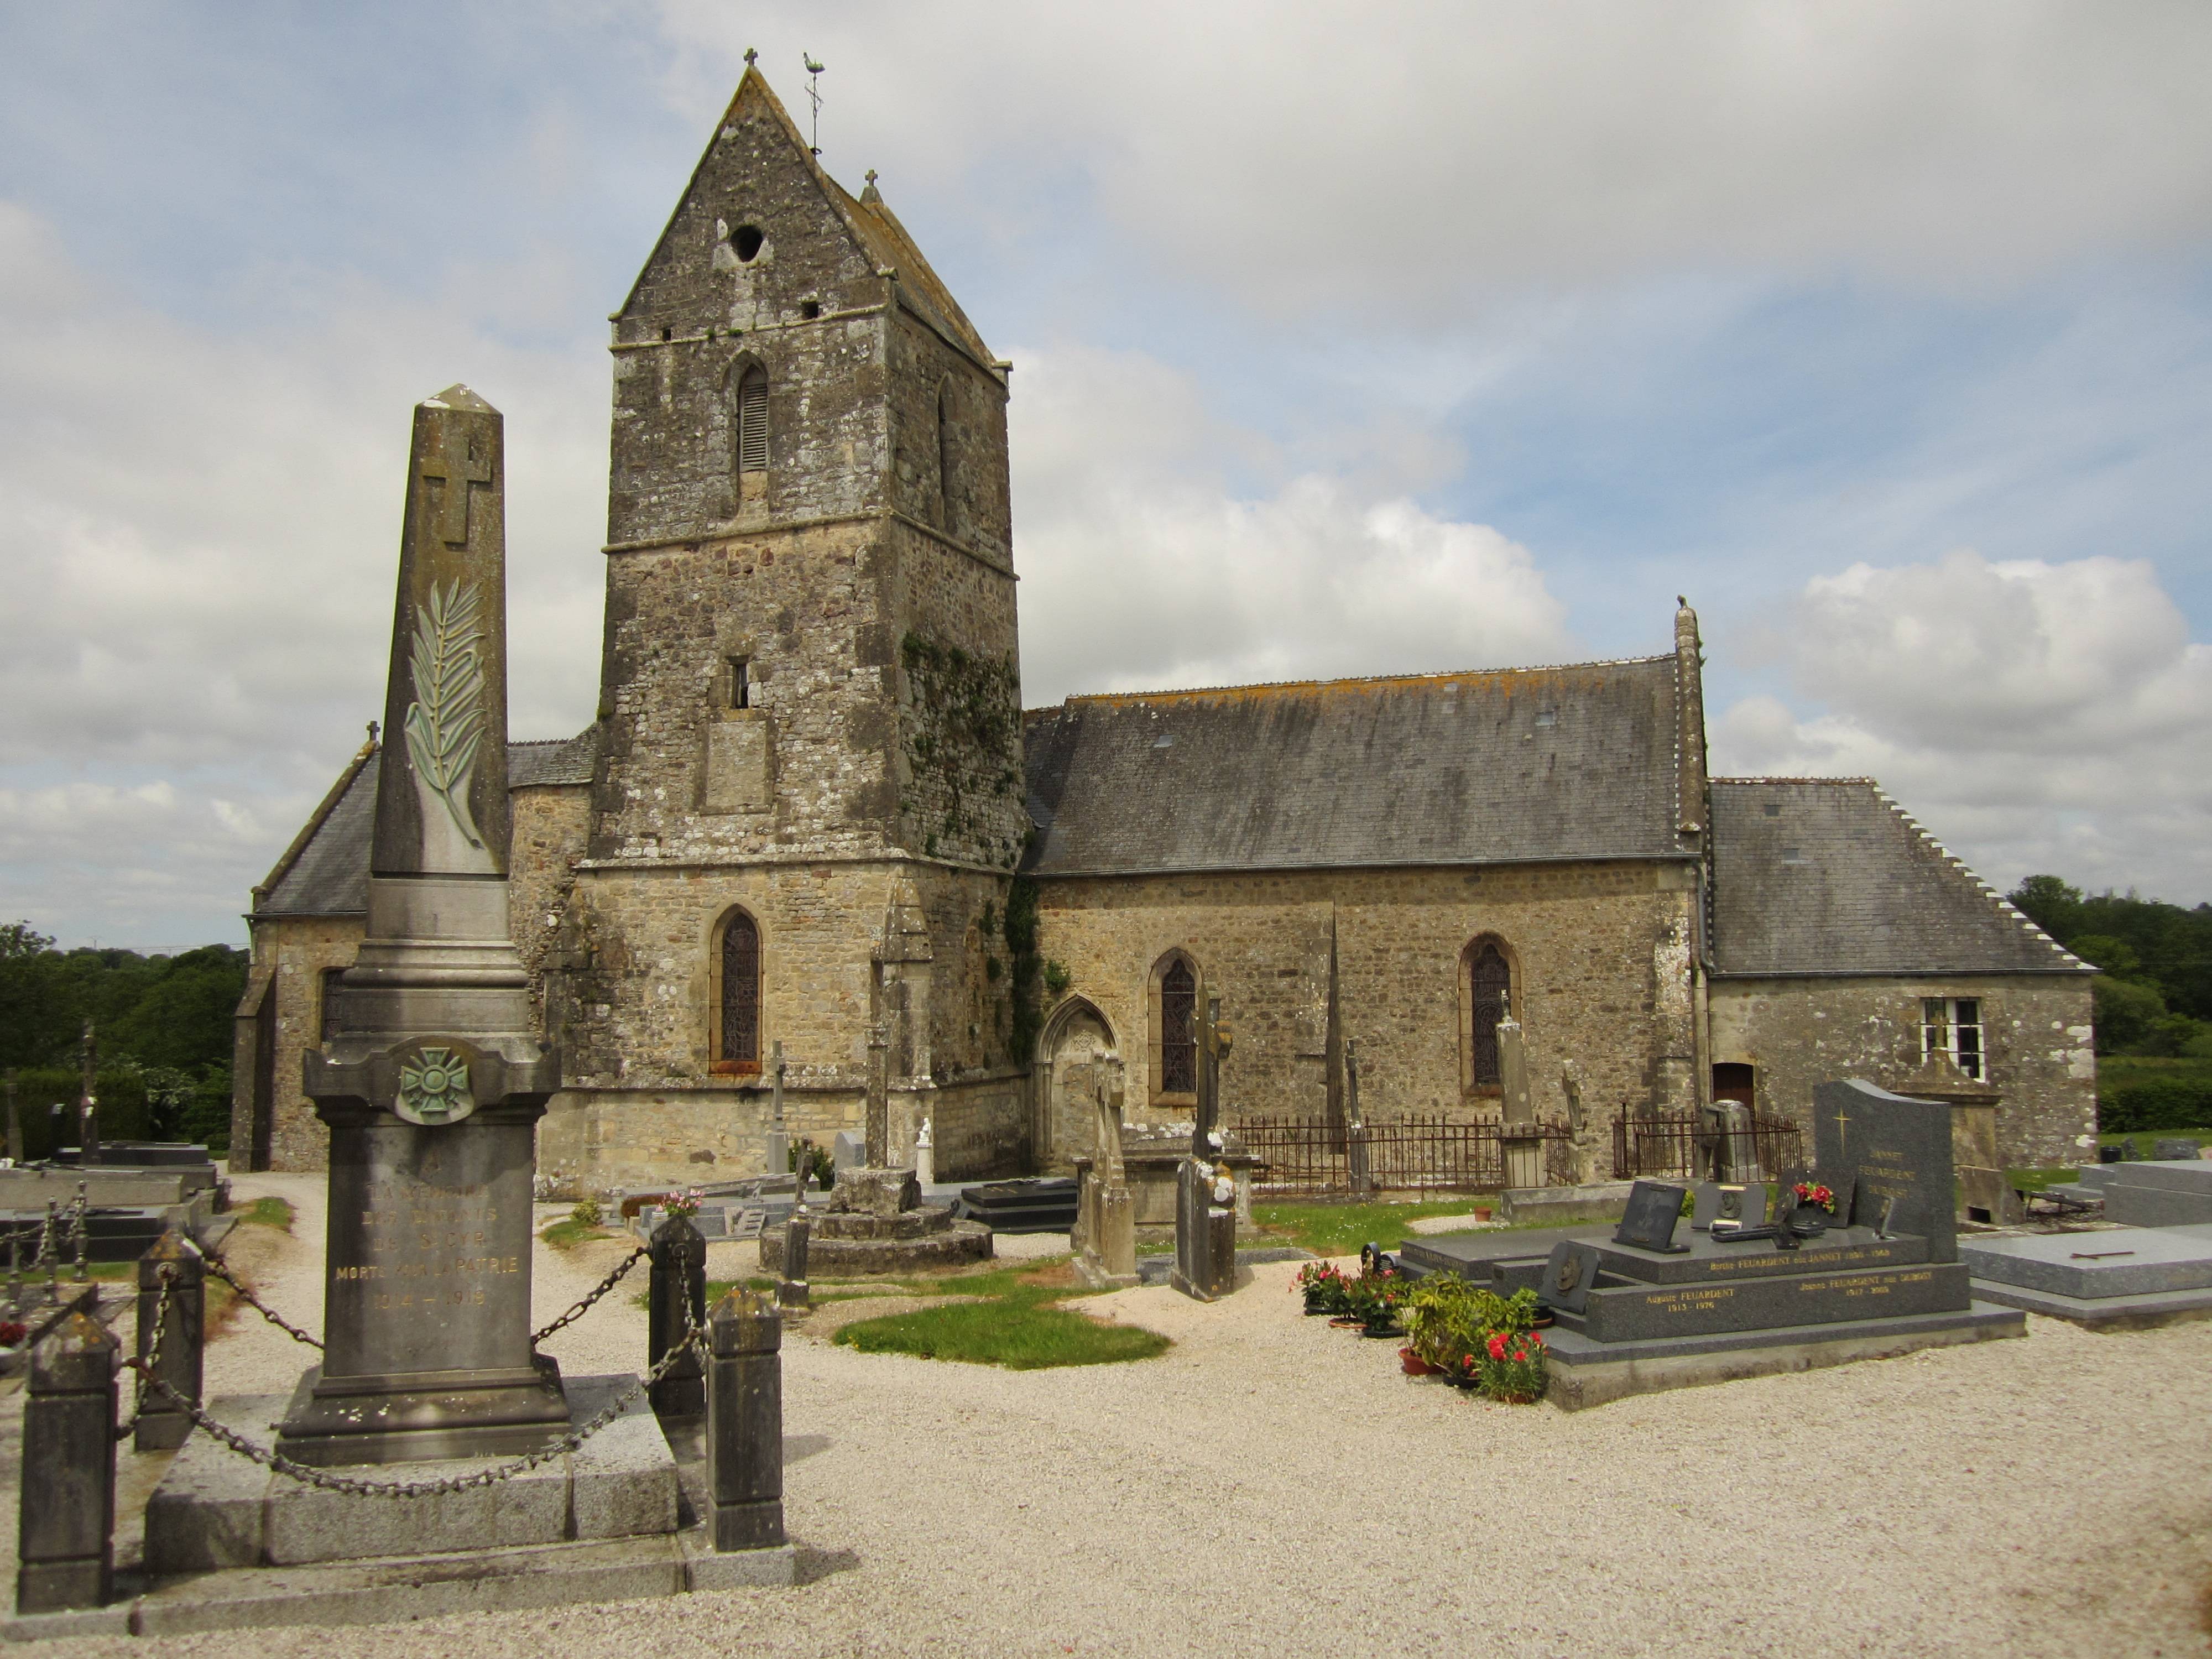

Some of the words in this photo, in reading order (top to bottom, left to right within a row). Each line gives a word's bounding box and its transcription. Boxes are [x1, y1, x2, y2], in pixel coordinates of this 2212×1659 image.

[446, 1232, 487, 1248] CYR
[1739, 1256, 1790, 1269] FEUARDENT
[1808, 1251, 1841, 1263] JANNET
[335, 1267, 386, 1280] MORTS
[434, 1263, 450, 1276] LA
[454, 1258, 518, 1274] PATRIE
[1830, 1276, 1879, 1288] FEUARDENT
[446, 1290, 485, 1306] 1918
[1646, 1295, 1676, 1305] Auguste
[1681, 1288, 1735, 1300] FEUARDENT
[1668, 1303, 1687, 1312] 1913
